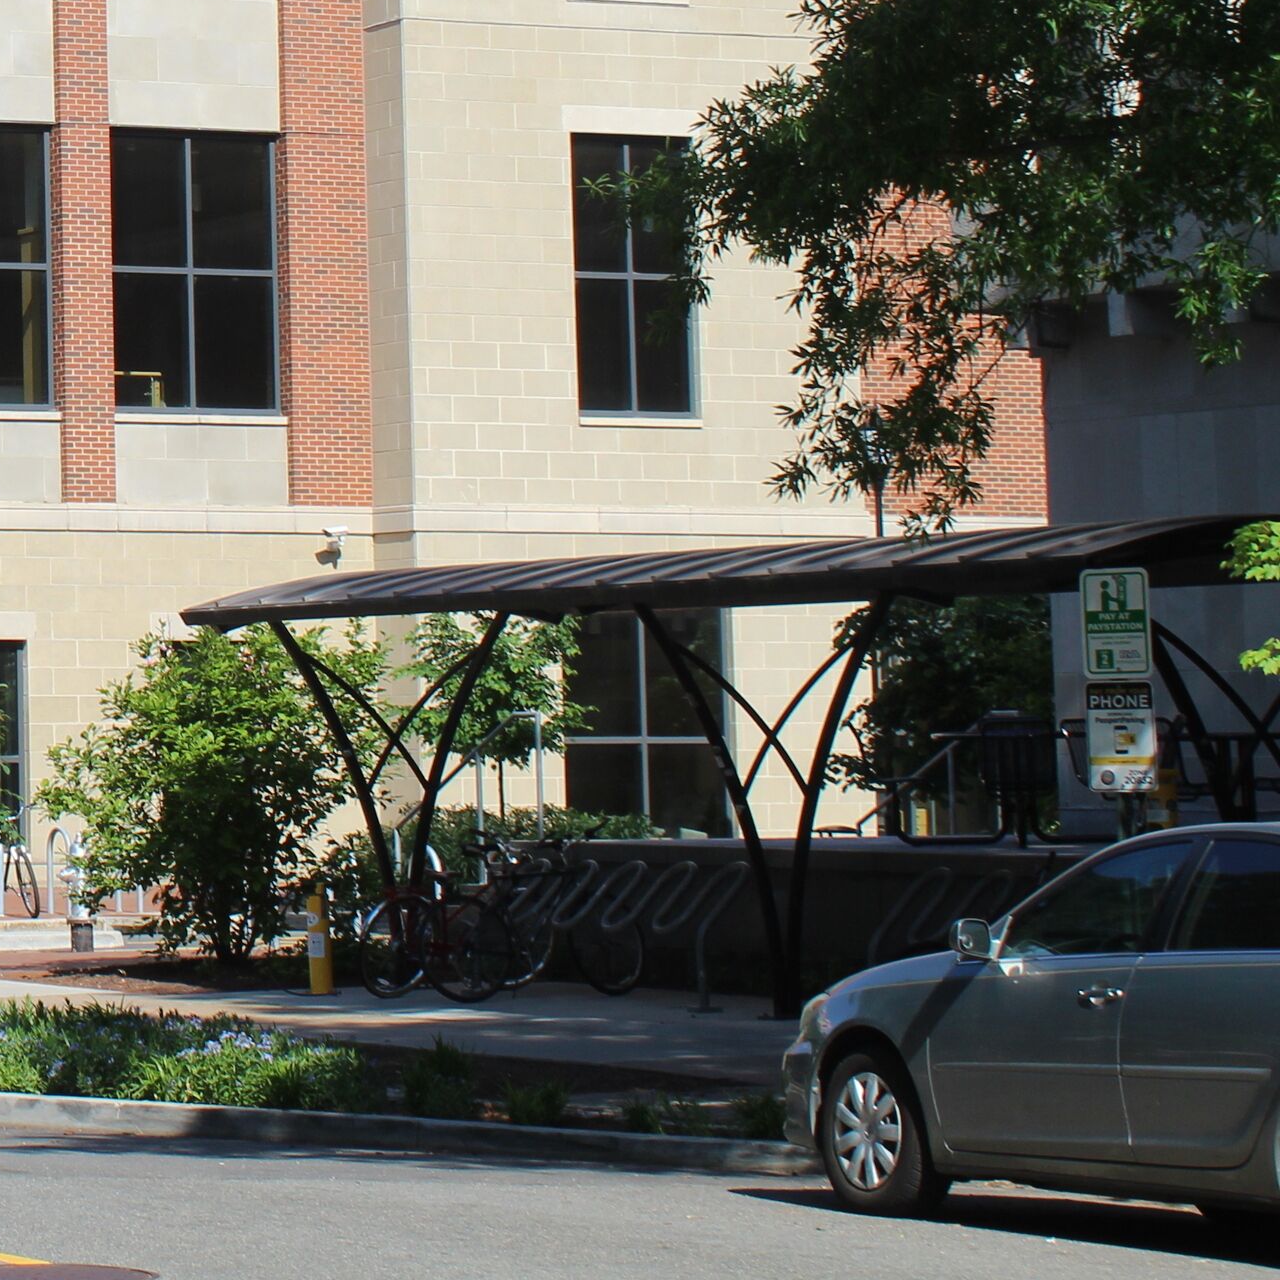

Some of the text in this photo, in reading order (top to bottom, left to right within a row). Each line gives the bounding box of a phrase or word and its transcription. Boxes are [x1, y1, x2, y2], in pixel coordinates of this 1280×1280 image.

[1098, 612, 1130, 621] PAY AT
[1087, 622, 1144, 632] PAYSTATION
[1101, 654, 1109, 665] 2
[1089, 694, 1149, 708] PHONE
